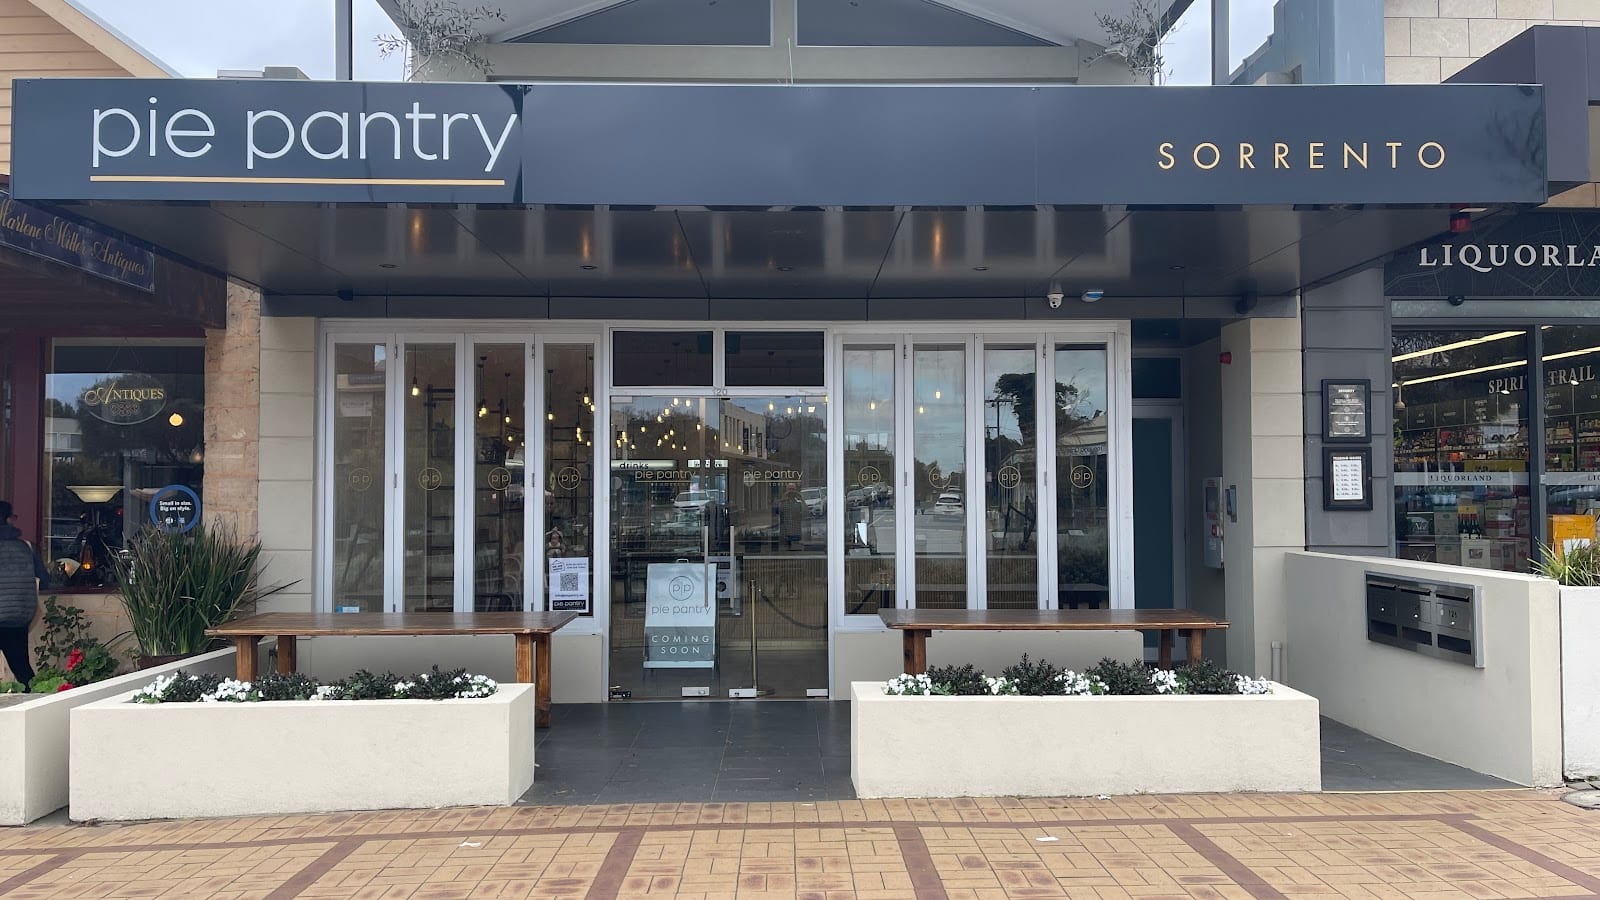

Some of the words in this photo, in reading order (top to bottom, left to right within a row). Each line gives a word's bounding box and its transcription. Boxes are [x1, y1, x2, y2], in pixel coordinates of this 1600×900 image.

[92, 96, 215, 168] pie
[246, 102, 518, 172] pantry
[1158, 142, 1445, 169] SORRENTO
[45, 216, 86, 255] Miller
[94, 239, 145, 278] Antiques
[1488, 375, 1528, 394] SPIRI
[1548, 365, 1595, 386] TRAIL
[620, 461, 649, 470] drinks
[635, 470, 653, 480] pie
[656, 470, 696, 480] pantry
[764, 470, 804, 481] pantry
[1430, 474, 1492, 483] LIQUORLAND
[651, 604, 670, 616] pie
[672, 605, 712, 616] pantry
[651, 635, 710, 643] COMING
[661, 646, 701, 654] SOON
